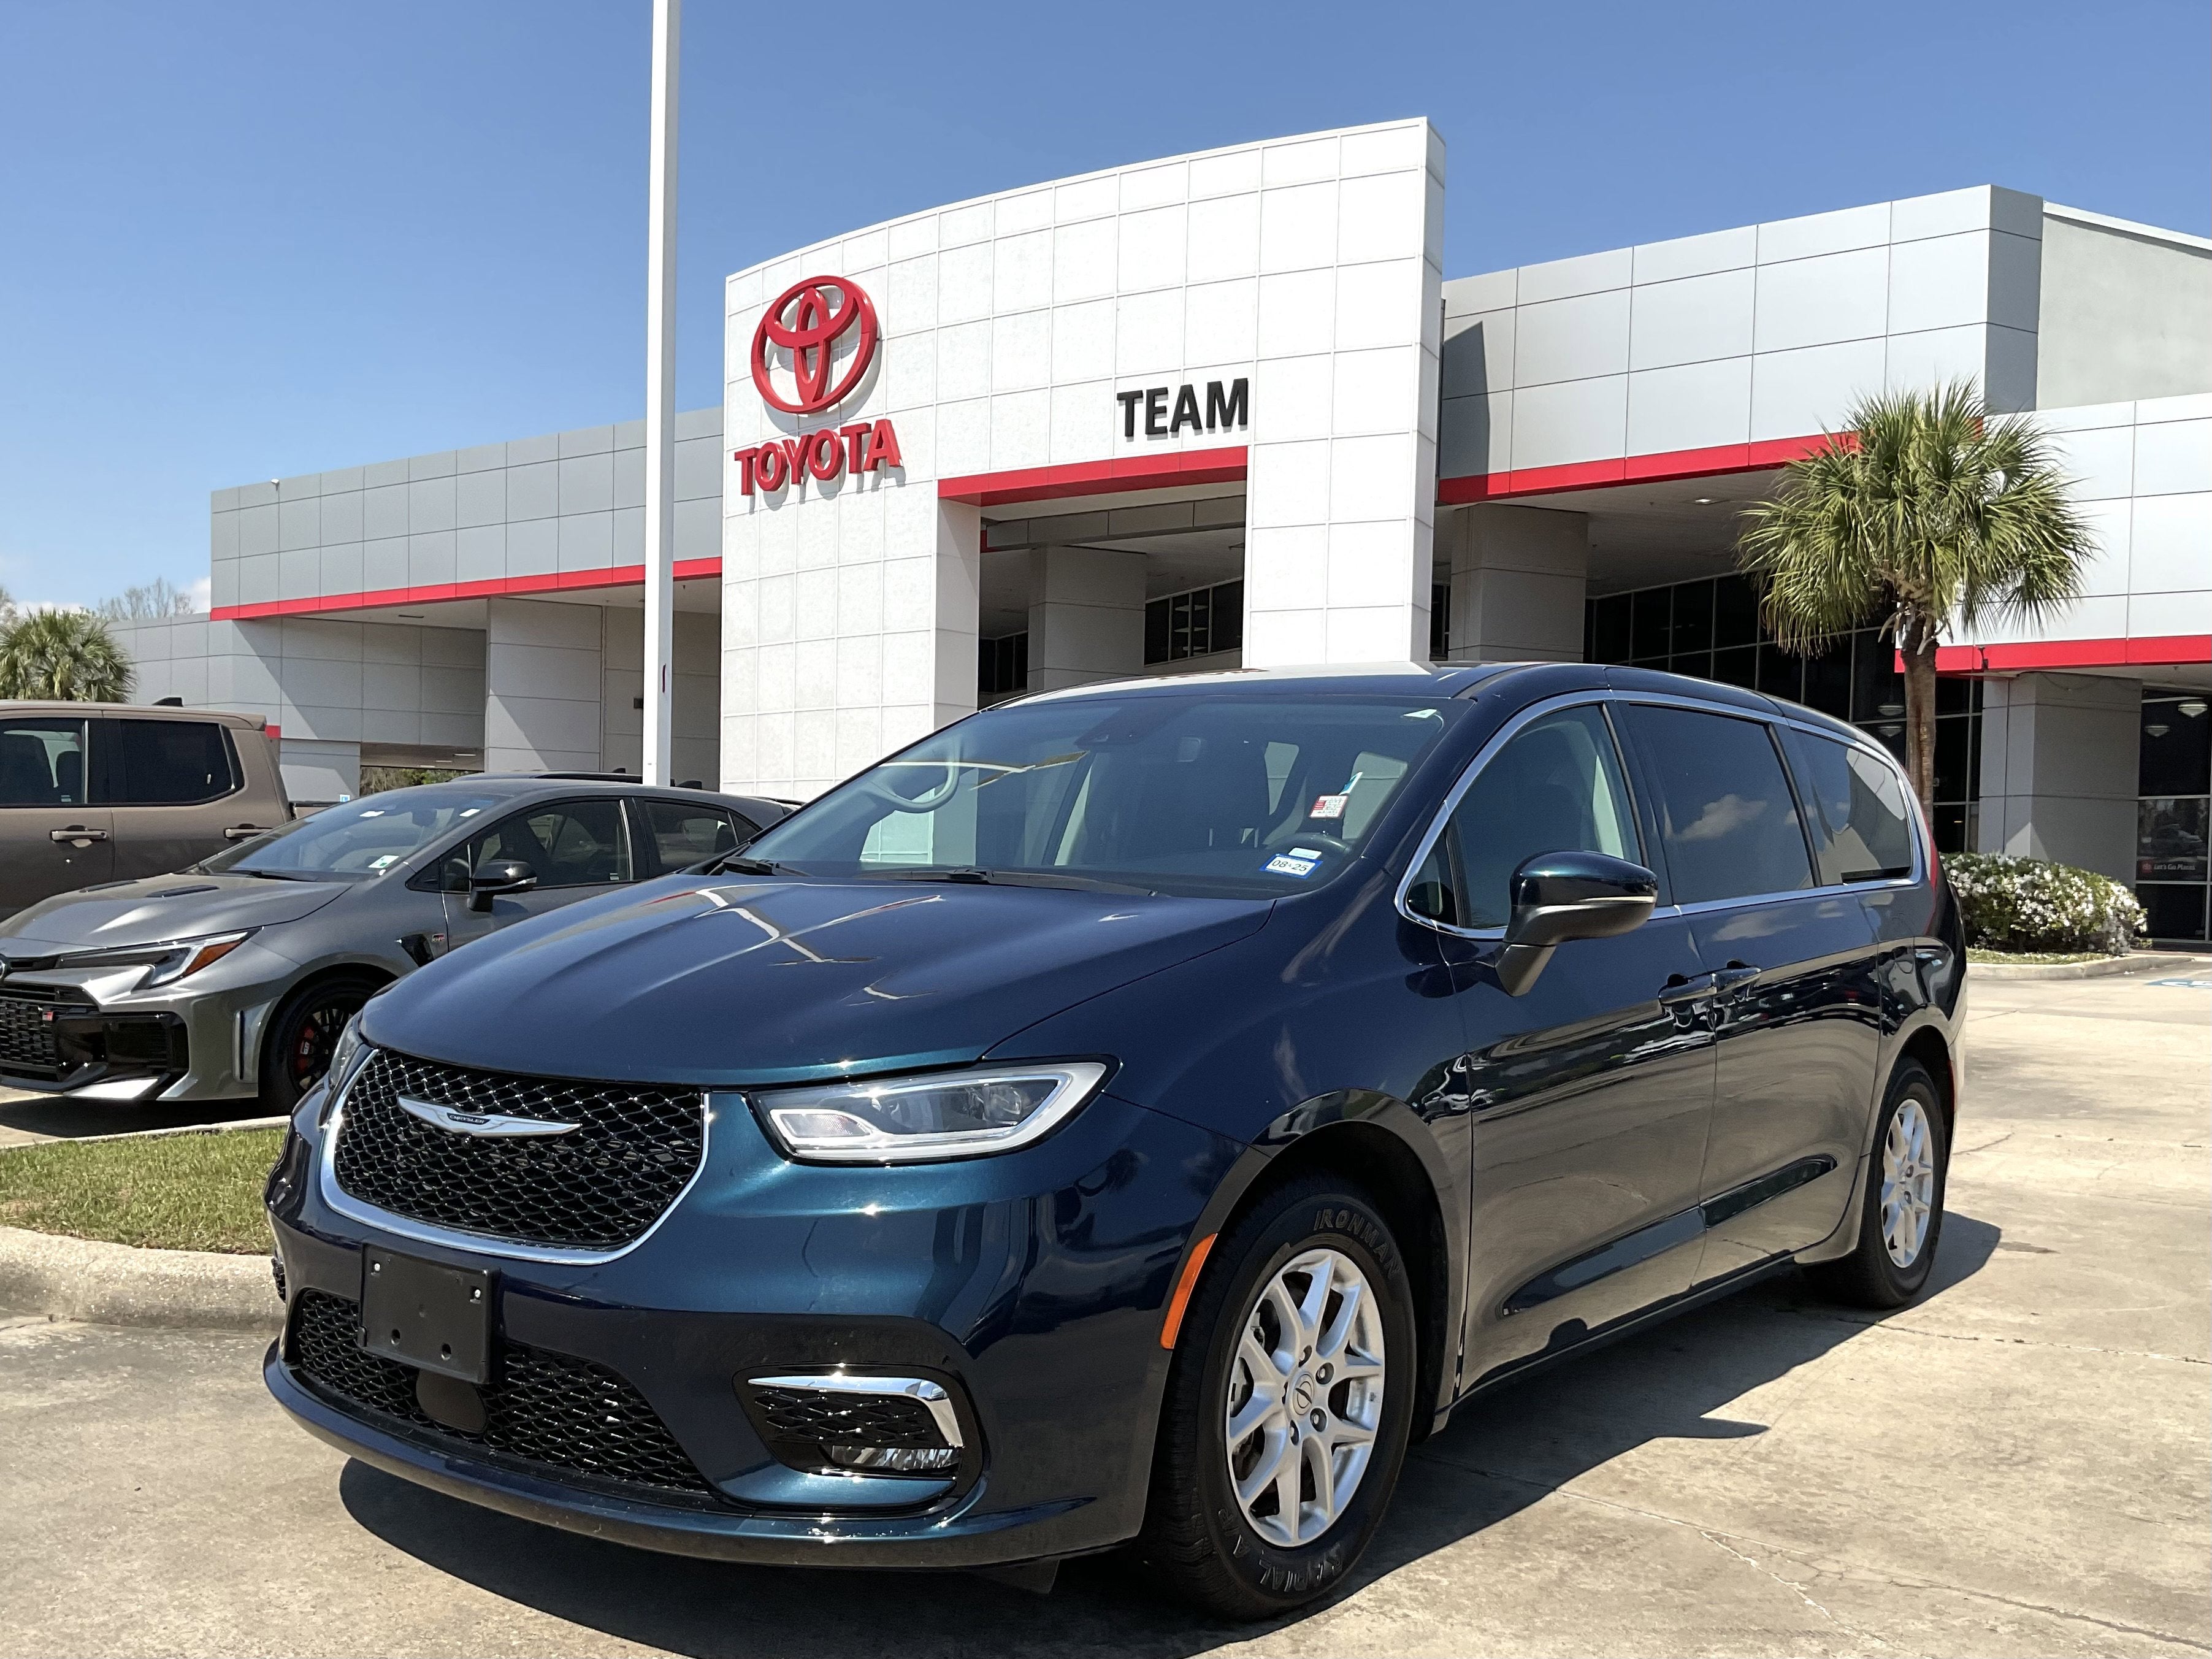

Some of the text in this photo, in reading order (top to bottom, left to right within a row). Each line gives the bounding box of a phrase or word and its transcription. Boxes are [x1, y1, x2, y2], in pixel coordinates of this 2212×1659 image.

[1117, 378, 1249, 437] TEAM
[735, 419, 905, 496] TOYOTA
[450, 1115, 484, 1124] CHRYSLER
[1313, 1208, 1401, 1278] IRONMAN
